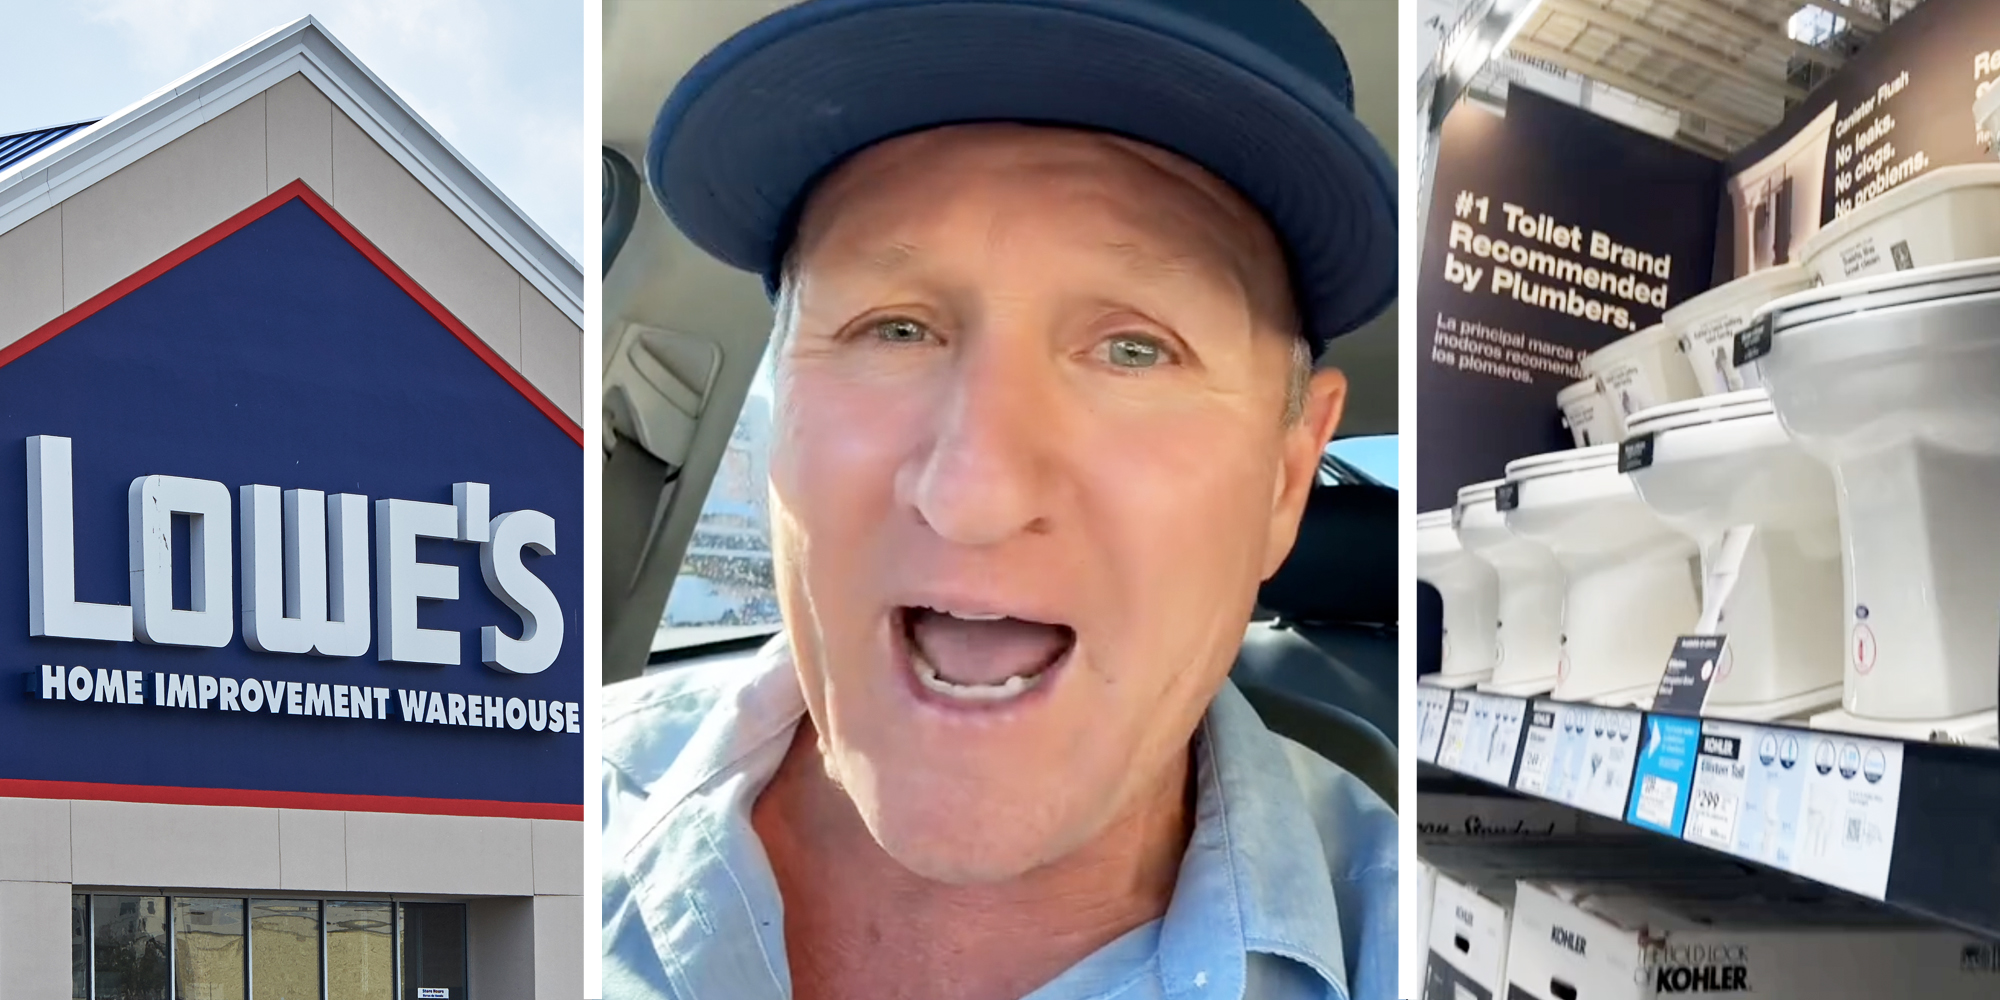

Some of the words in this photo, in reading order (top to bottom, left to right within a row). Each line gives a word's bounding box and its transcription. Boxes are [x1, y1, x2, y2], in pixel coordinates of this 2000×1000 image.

[1835, 95, 1875, 139] Canister
[1877, 70, 1910, 107] Flush
[1835, 144, 1853, 170] No
[1855, 114, 1896, 154] leaks.
[1835, 172, 1853, 198] No
[1855, 142, 1896, 182] clogs.
[1835, 199, 1852, 221] No
[1855, 151, 1930, 208] problems.
[1449, 219, 1669, 310] Recommended
[1454, 189, 1490, 224] #1
[1502, 202, 1583, 252] Toilet
[1589, 230, 1672, 280] Brand
[1444, 252, 1483, 292] by
[1491, 266, 1637, 331] Plumbers.
[1431, 345, 1455, 367] los
[1458, 354, 1534, 385] plomeros.
[1436, 311, 1457, 332] La
[1460, 319, 1526, 349] principal
[1528, 338, 1573, 362] marca
[26, 434, 565, 675] LOWE'S
[41, 664, 144, 705] HOME
[155, 672, 390, 720] IMPROVEMENT
[398, 688, 581, 734] WAREHOUSE
[1703, 736, 1734, 757] KOHLER
[1551, 924, 1587, 954] KOHLER
